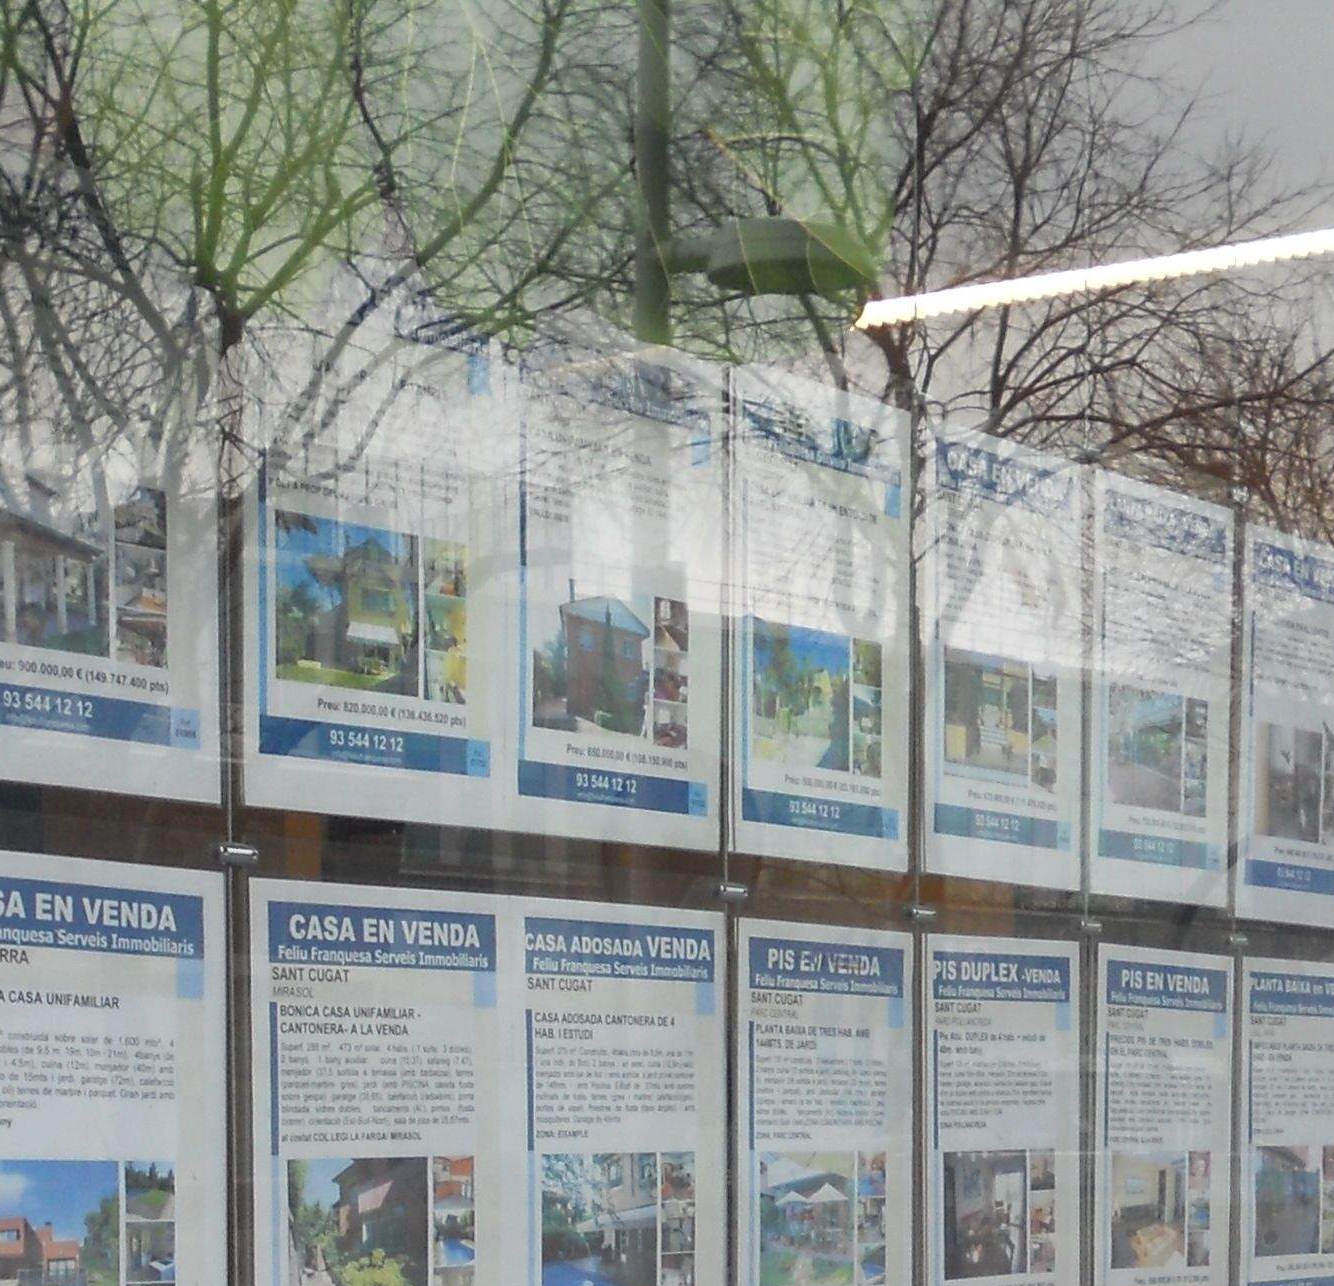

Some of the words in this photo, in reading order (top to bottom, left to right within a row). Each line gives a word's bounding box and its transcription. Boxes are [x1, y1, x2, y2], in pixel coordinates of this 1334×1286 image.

[3, 691, 20, 710] 93
[24, 693, 52, 714] 544
[57, 697, 72, 716] 12
[78, 699, 93, 718] 12
[330, 730, 344, 747] 93
[347, 732, 370, 749] 544
[374, 734, 386, 751] 12
[390, 736, 403, 752] 12
[36, 894, 73, 922] EN
[83, 898, 176, 931] VENDA
[289, 914, 355, 941] CASA
[364, 918, 394, 943] EN
[401, 920, 480, 947] VENDA
[525, 932, 566, 953] CASA
[572, 935, 642, 957] ADOSADA
[647, 935, 710, 961] VENDA
[272, 966, 304, 982] SANT
[308, 968, 349, 983] CUGAT
[768, 948, 794, 972] PIS
[828, 952, 881, 976] VENDA
[933, 959, 956, 981] PIS
[962, 960, 1018, 983] DUPLEX
[1122, 969, 1144, 990] PIS
[1148, 971, 1164, 991] EN
[1167, 973, 1209, 995] VENDA
